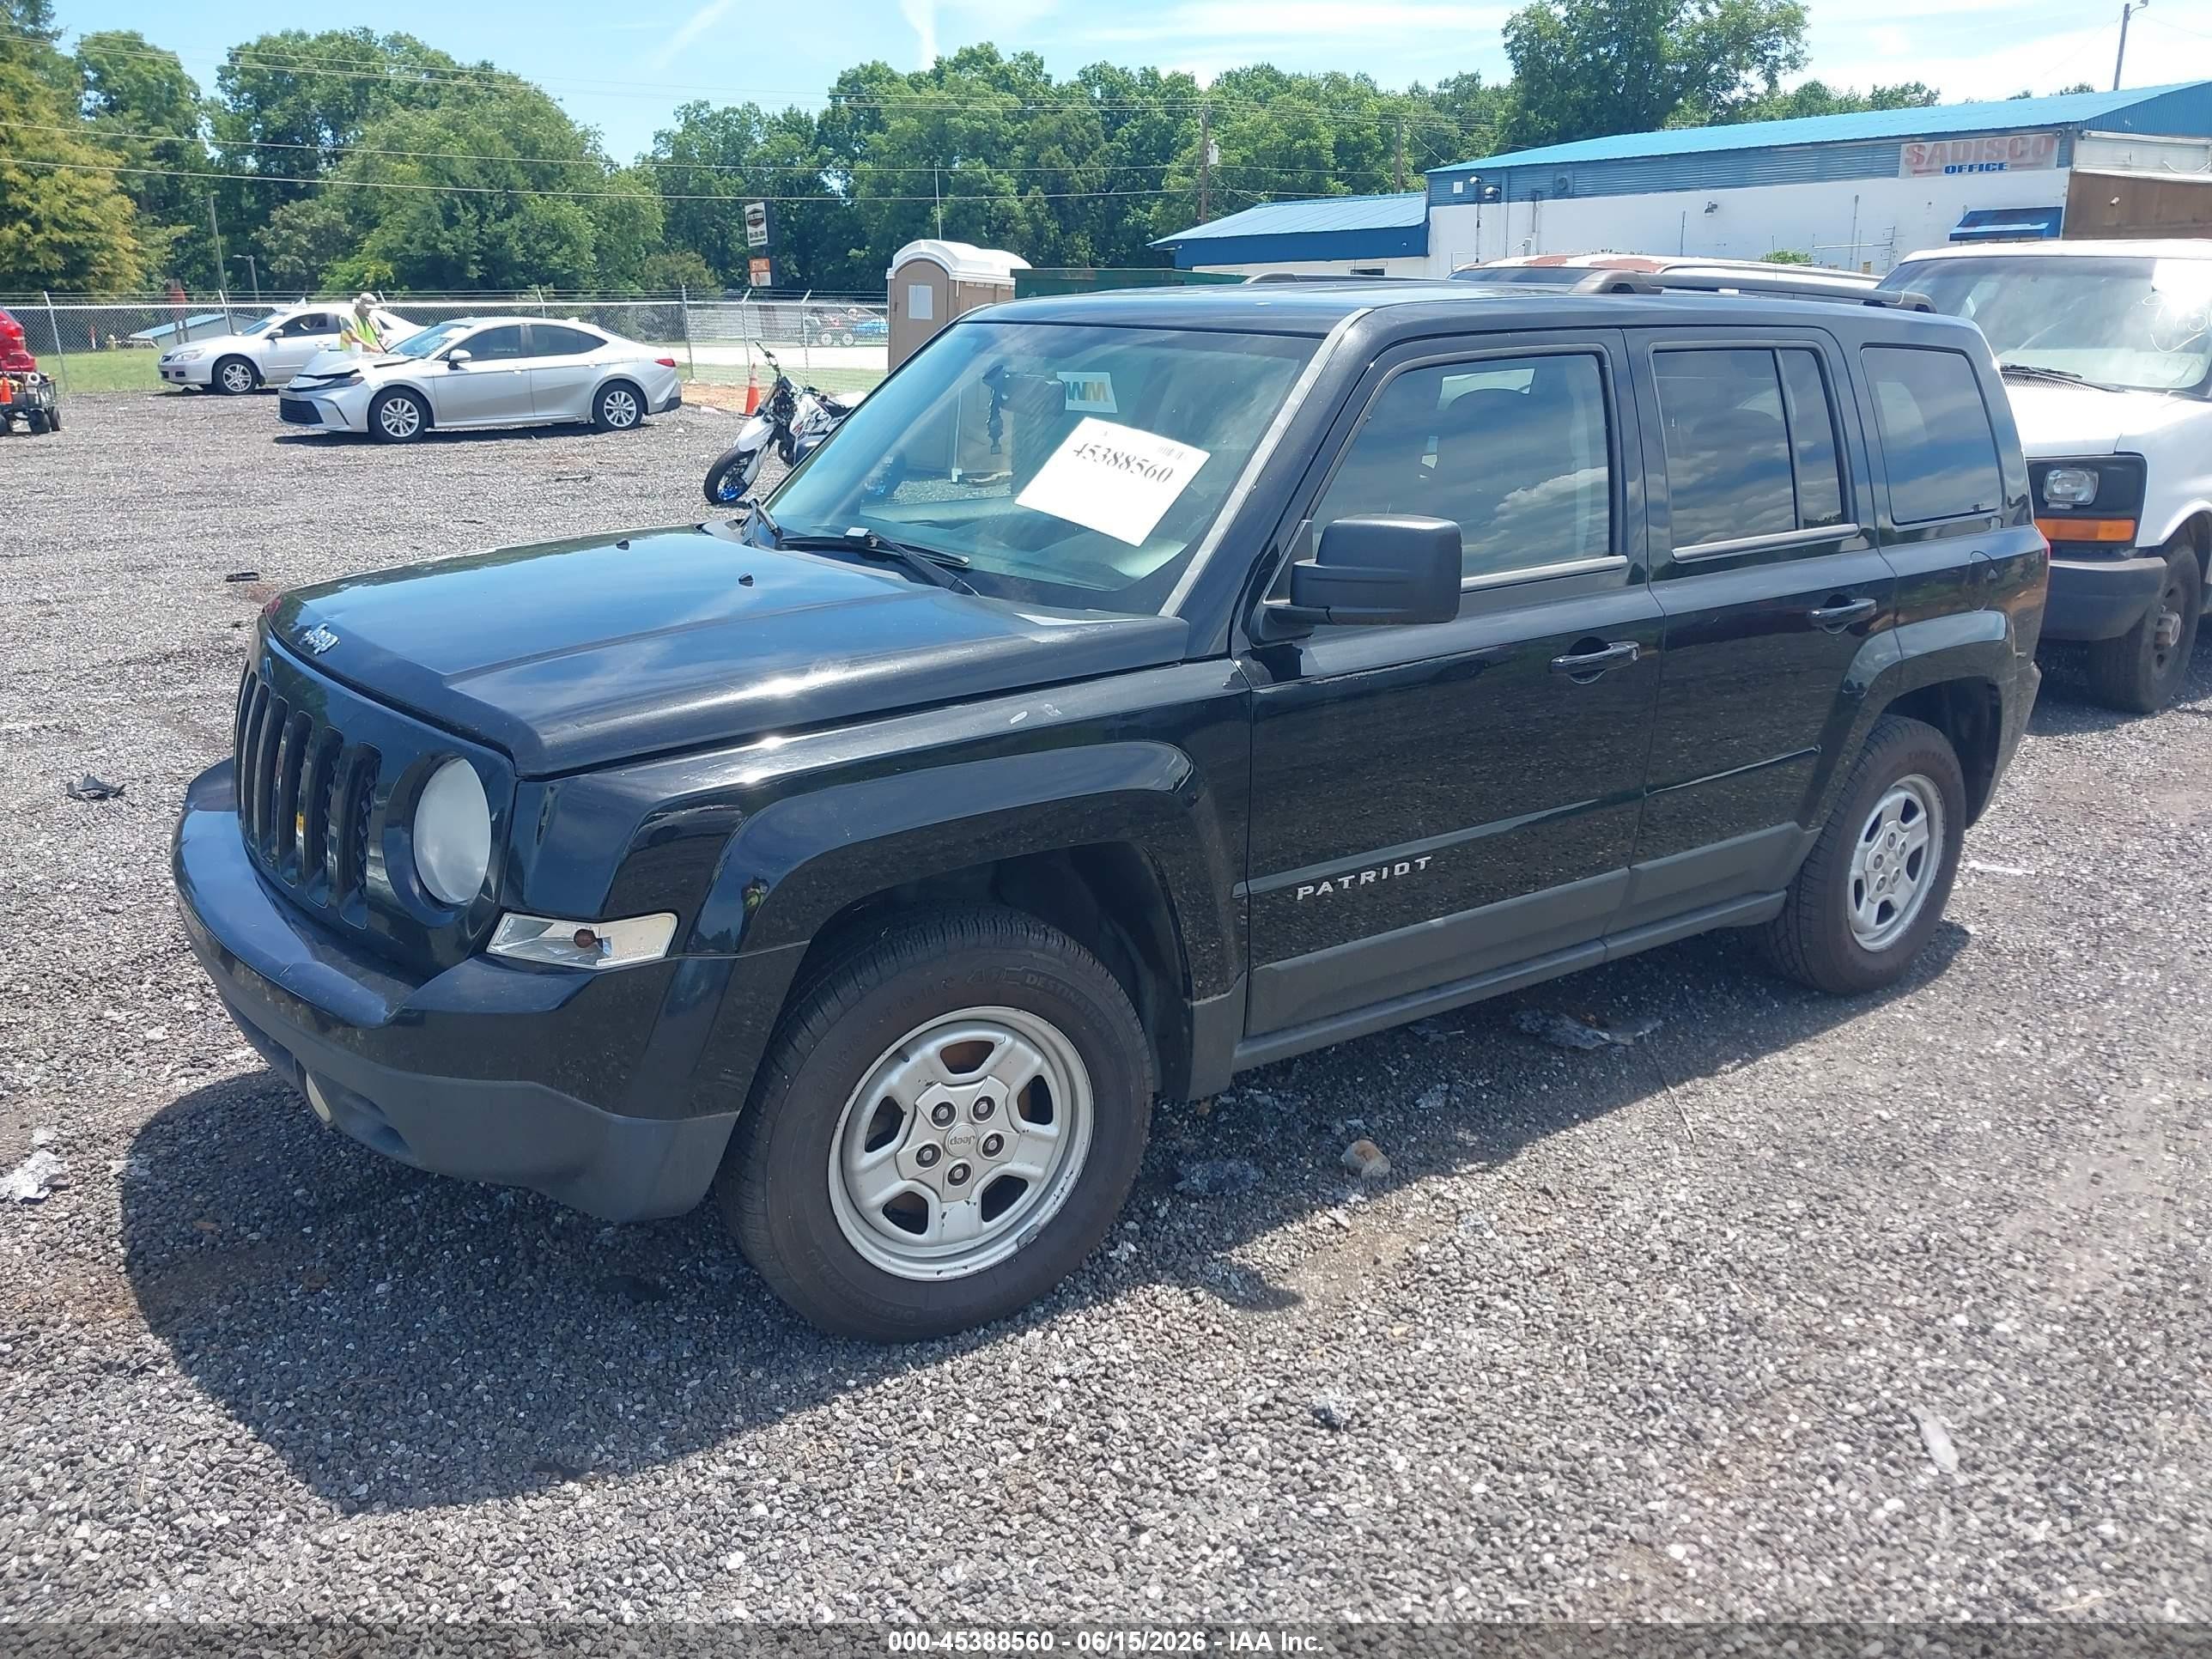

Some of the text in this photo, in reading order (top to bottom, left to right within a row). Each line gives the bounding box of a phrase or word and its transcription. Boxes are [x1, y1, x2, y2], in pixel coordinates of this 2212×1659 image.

[1905, 135, 2054, 166] SADISCO
[1944, 161, 2008, 174] OFFICE
[1065, 381, 1114, 402] WM
[1073, 442, 1174, 483] 45388560
[1297, 856, 1432, 901] PATRIOT
[949, 1135, 976, 1146] Jeep
